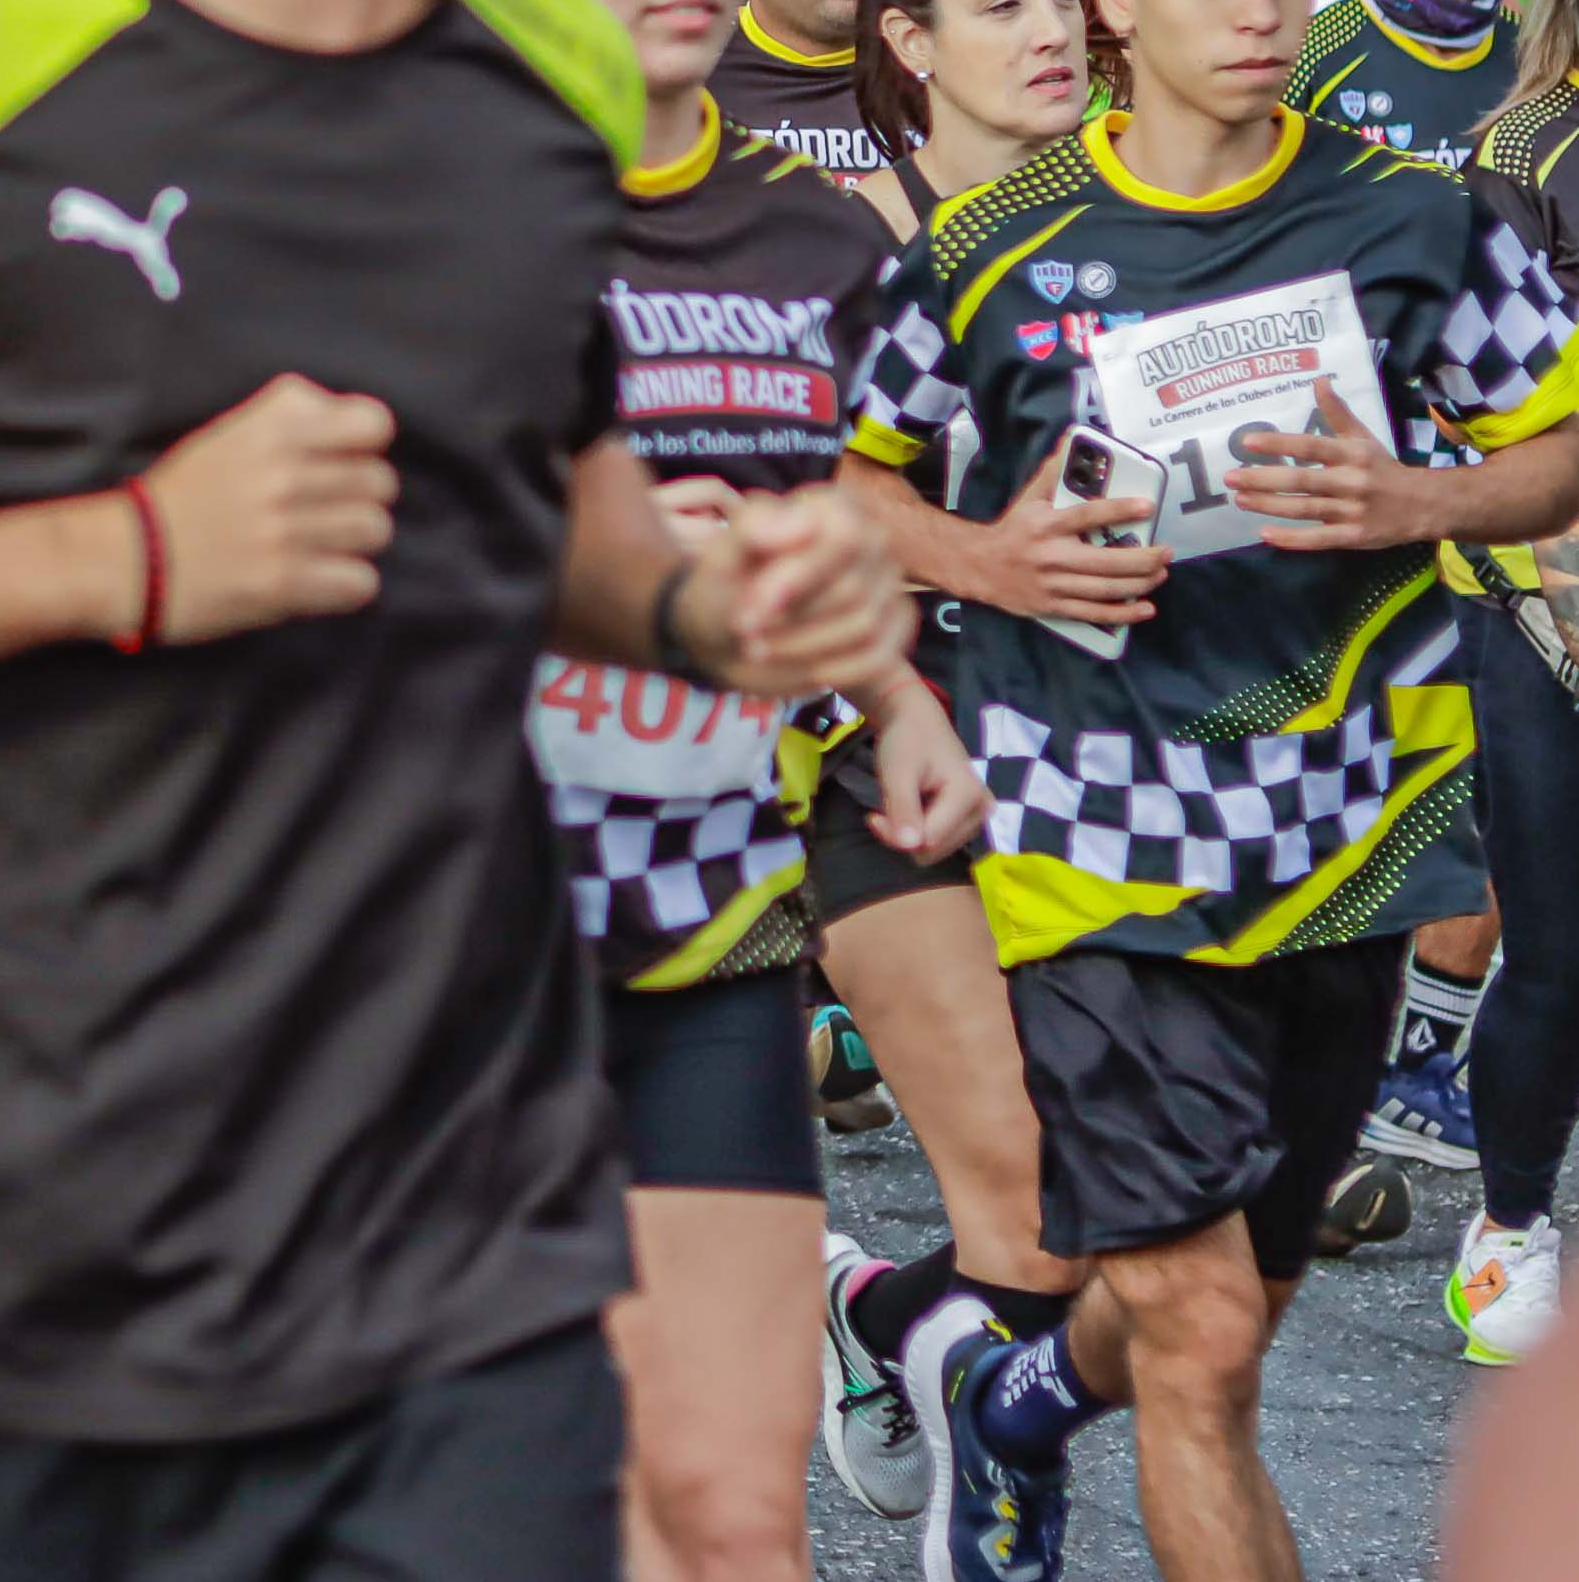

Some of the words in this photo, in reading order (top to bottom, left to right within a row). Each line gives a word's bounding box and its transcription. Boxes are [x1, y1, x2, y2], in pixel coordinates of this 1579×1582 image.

[600, 279, 834, 367] ÓDROMO
[1137, 309, 1325, 387] AUTÓDROMO
[730, 365, 812, 415] RACE
[1174, 361, 1251, 401] RUNNING
[1255, 353, 1302, 378] RACE
[1164, 405, 1203, 424] Carrera
[1205, 400, 1220, 413] de
[1220, 396, 1236, 409] los
[1238, 387, 1273, 405] Clubes
[1275, 381, 1292, 395] del
[690, 429, 756, 455] Clubes
